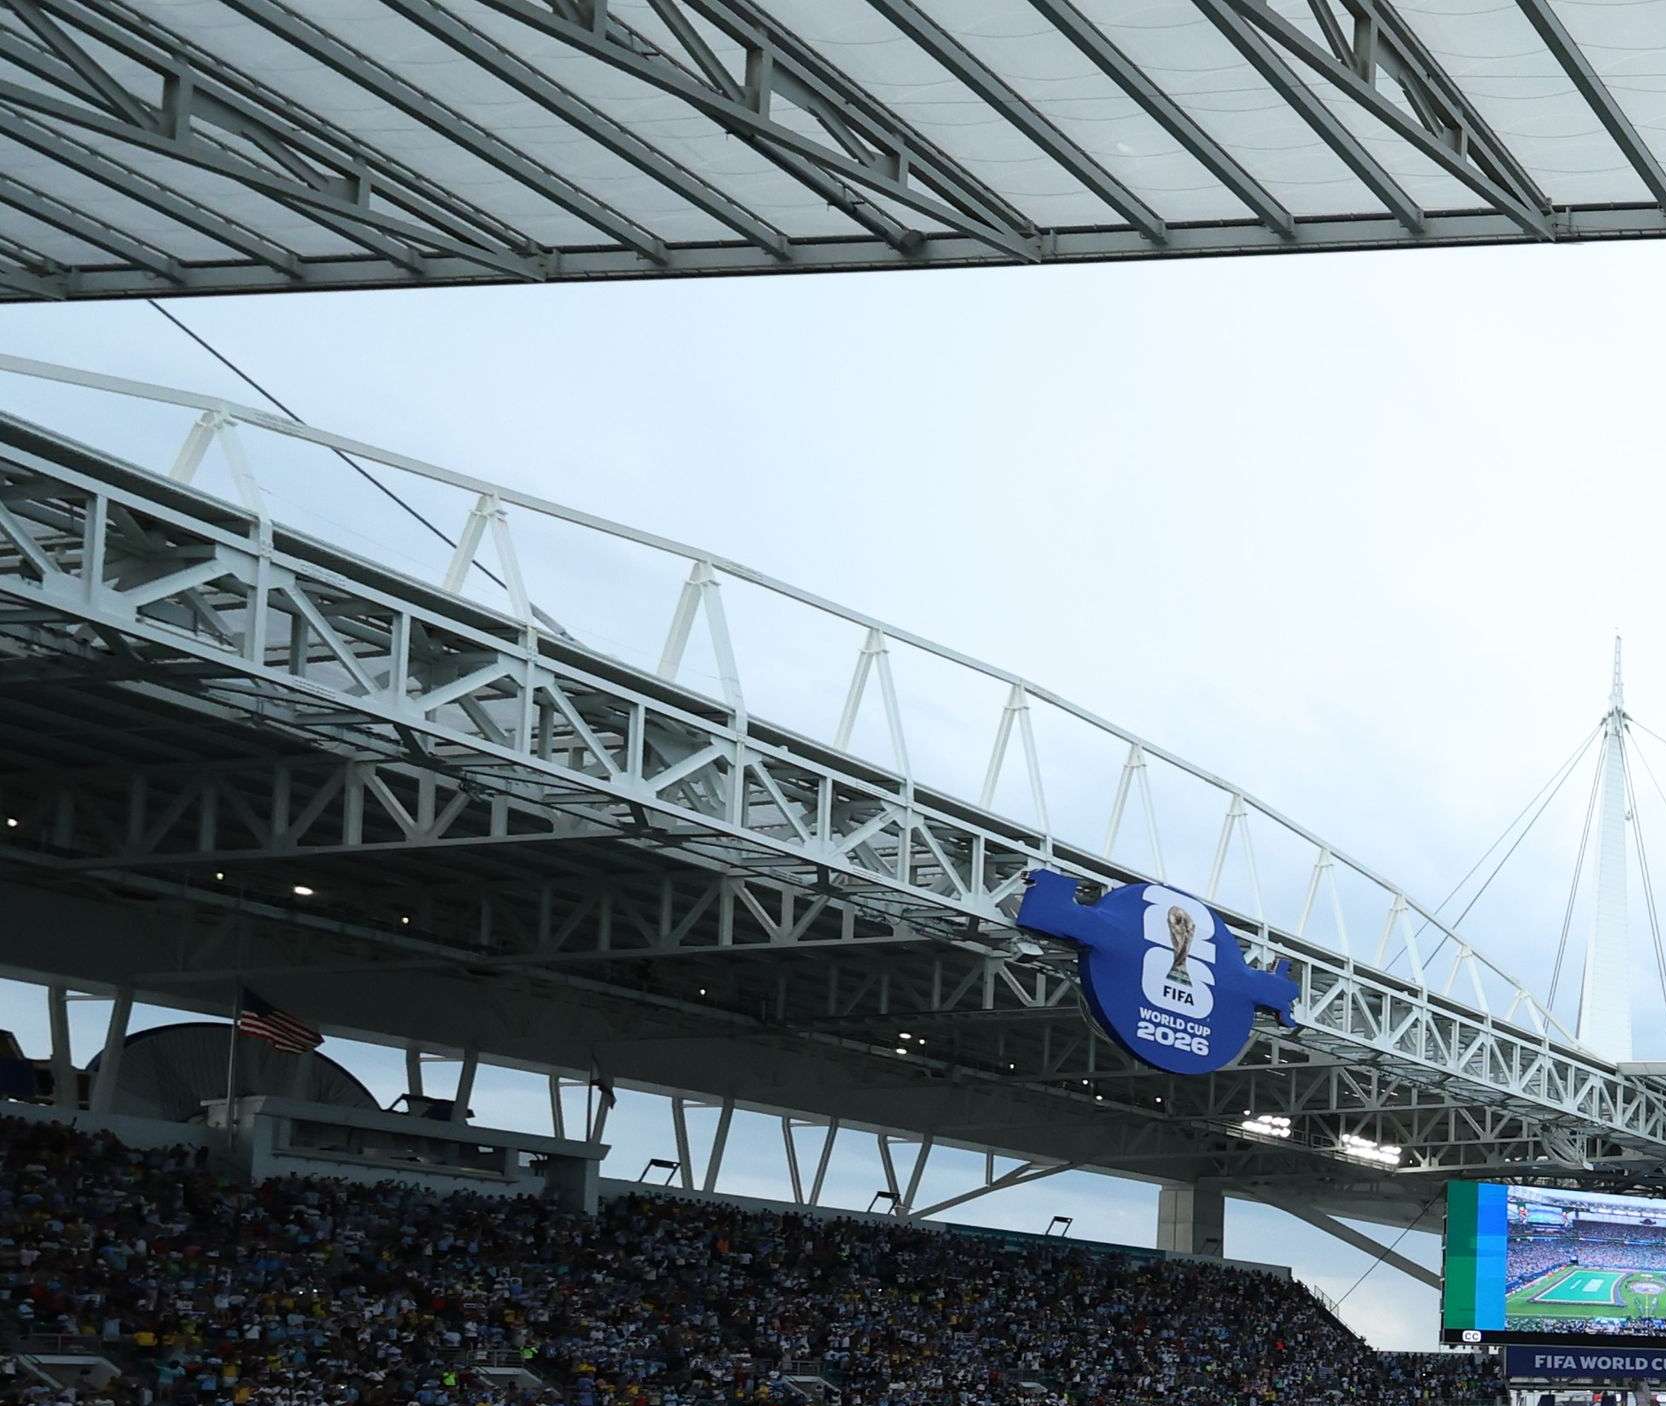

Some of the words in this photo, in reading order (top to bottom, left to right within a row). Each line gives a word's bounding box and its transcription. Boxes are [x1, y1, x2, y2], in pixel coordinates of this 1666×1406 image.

[1162, 985, 1195, 1006] FIFA
[1139, 1007, 1185, 1031] WORLD
[1186, 1019, 1211, 1038] CUP
[1137, 1021, 1209, 1056] 2026
[1464, 1332, 1480, 1341] CC
[1535, 1354, 1577, 1369] FIFA
[1580, 1355, 1648, 1371] WORLD
